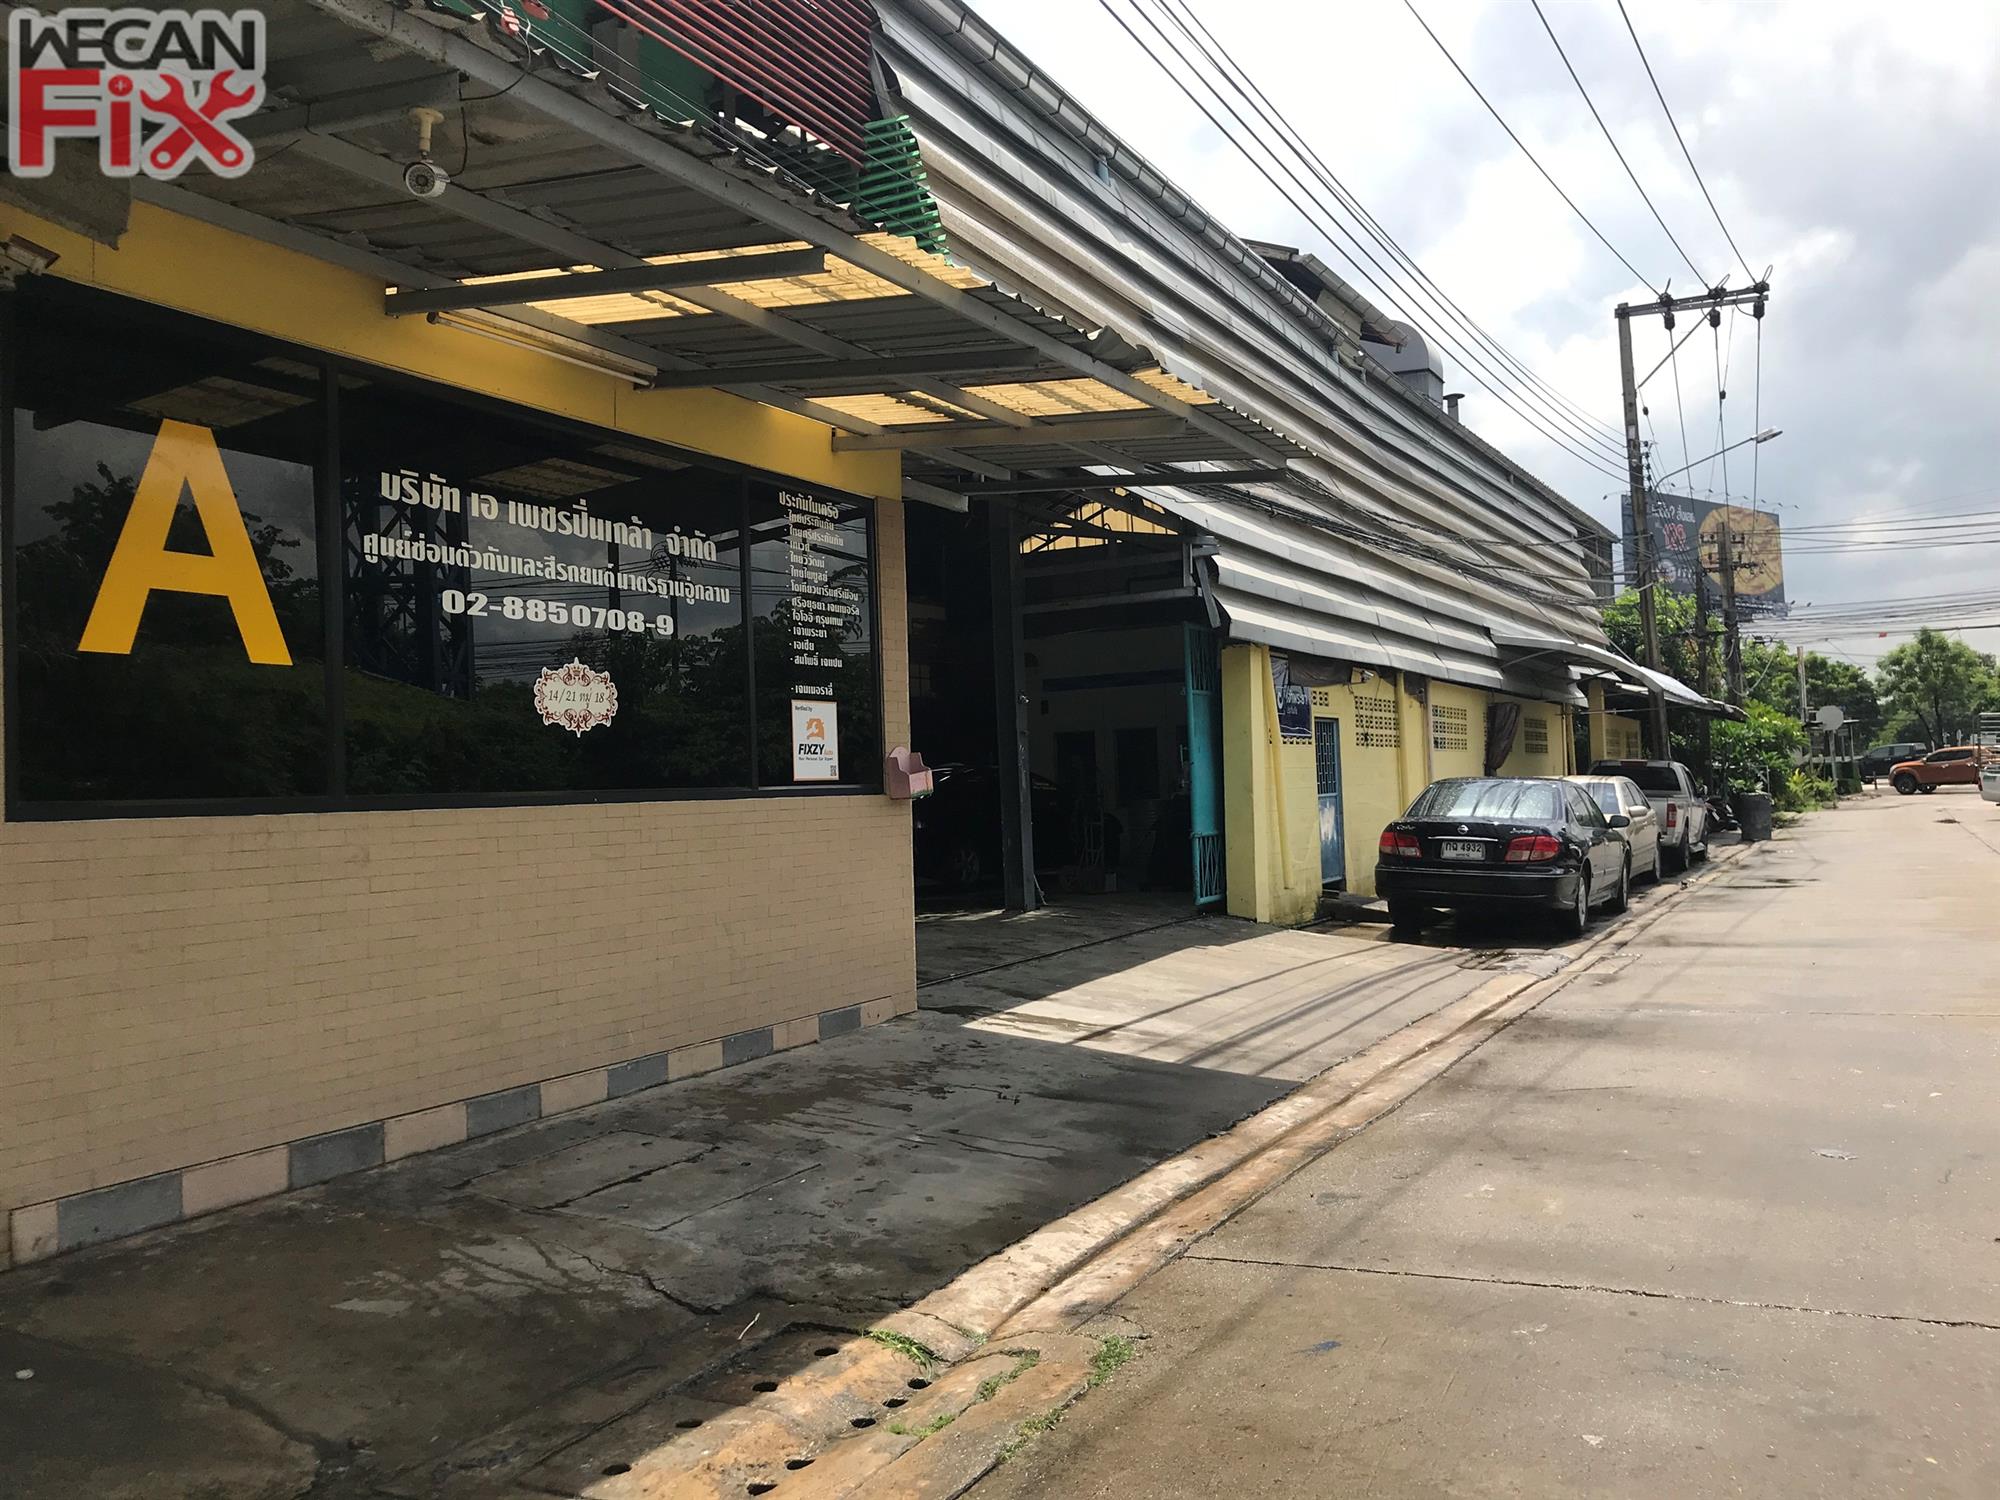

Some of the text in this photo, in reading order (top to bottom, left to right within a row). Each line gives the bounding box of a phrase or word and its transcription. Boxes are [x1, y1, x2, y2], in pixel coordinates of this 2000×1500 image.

[380, 468, 717, 561] บริษัท เอ เพชรปิ่นเกล้า จำกัด
[778, 491, 839, 519] ประกันในเครือ
[77, 417, 294, 667] A
[441, 589, 675, 637] 02-8850708-9
[793, 622, 827, 638] เจ้าพระยา
[594, 691, 605, 703] 18
[798, 743, 825, 755] FIXZY
[1460, 842, 1482, 853] 4932
